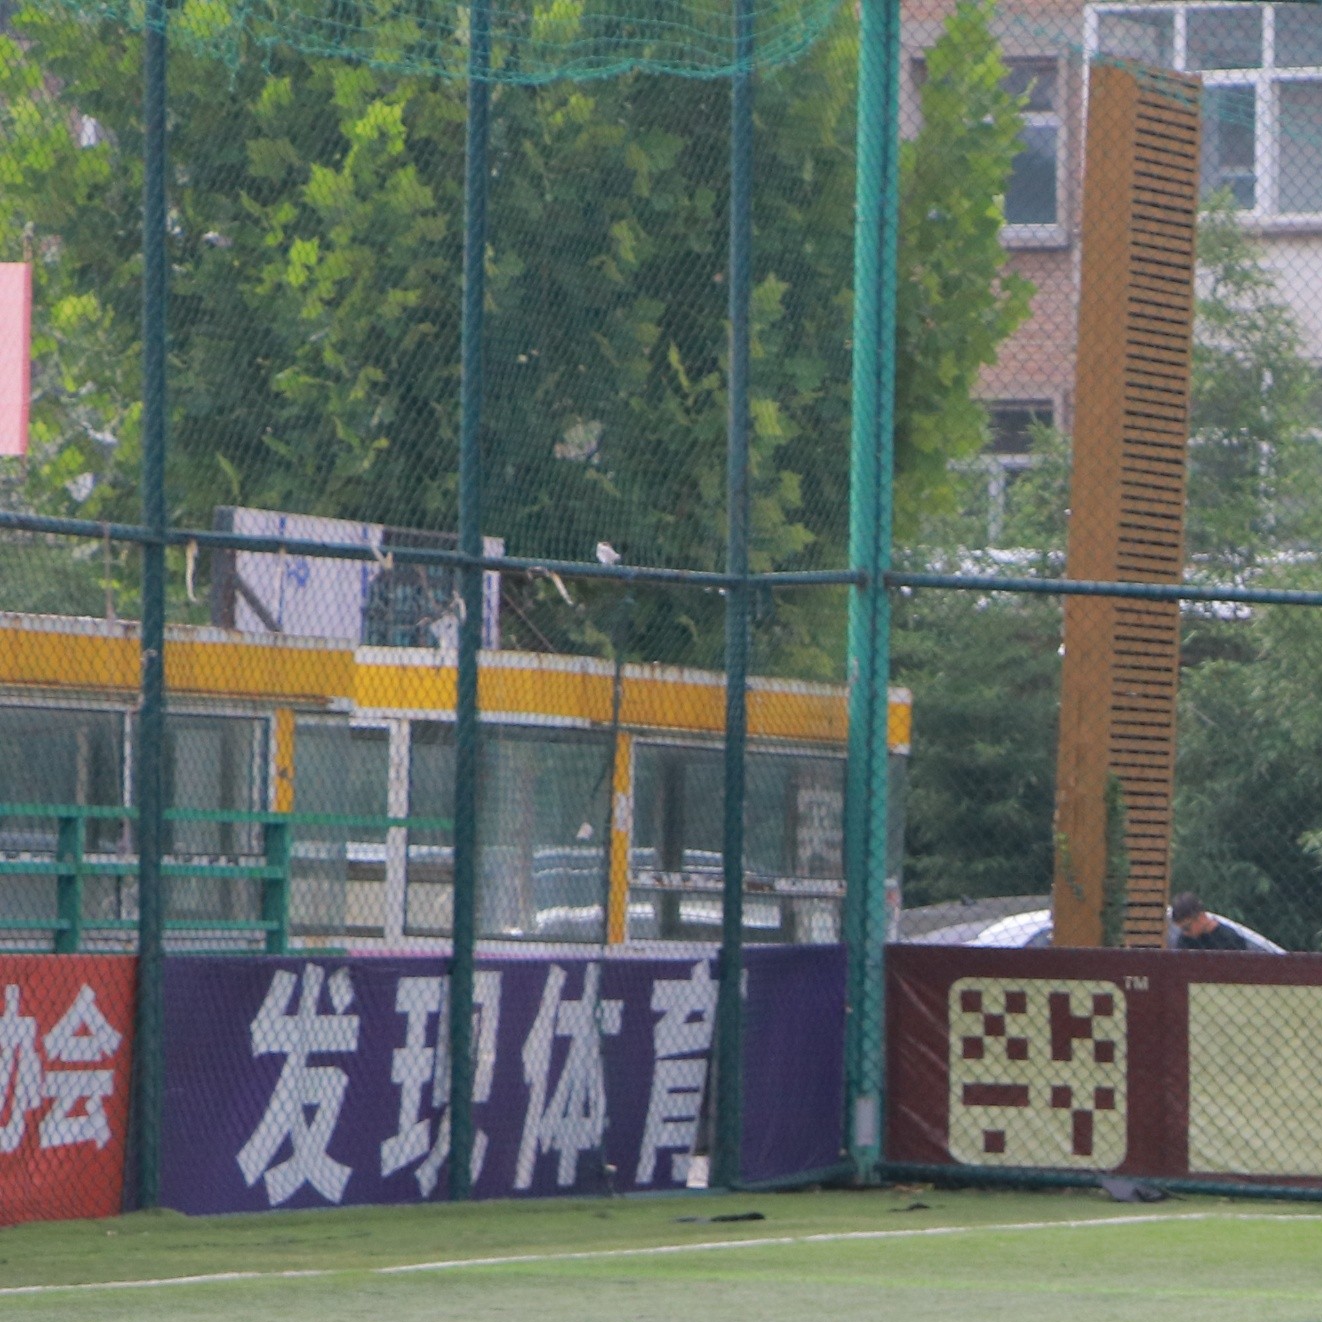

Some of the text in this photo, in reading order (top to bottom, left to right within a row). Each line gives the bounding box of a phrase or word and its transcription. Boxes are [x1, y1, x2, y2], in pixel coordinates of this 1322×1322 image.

[1123, 975, 1149, 990] TM
[236, 959, 748, 1206] 发现体育
